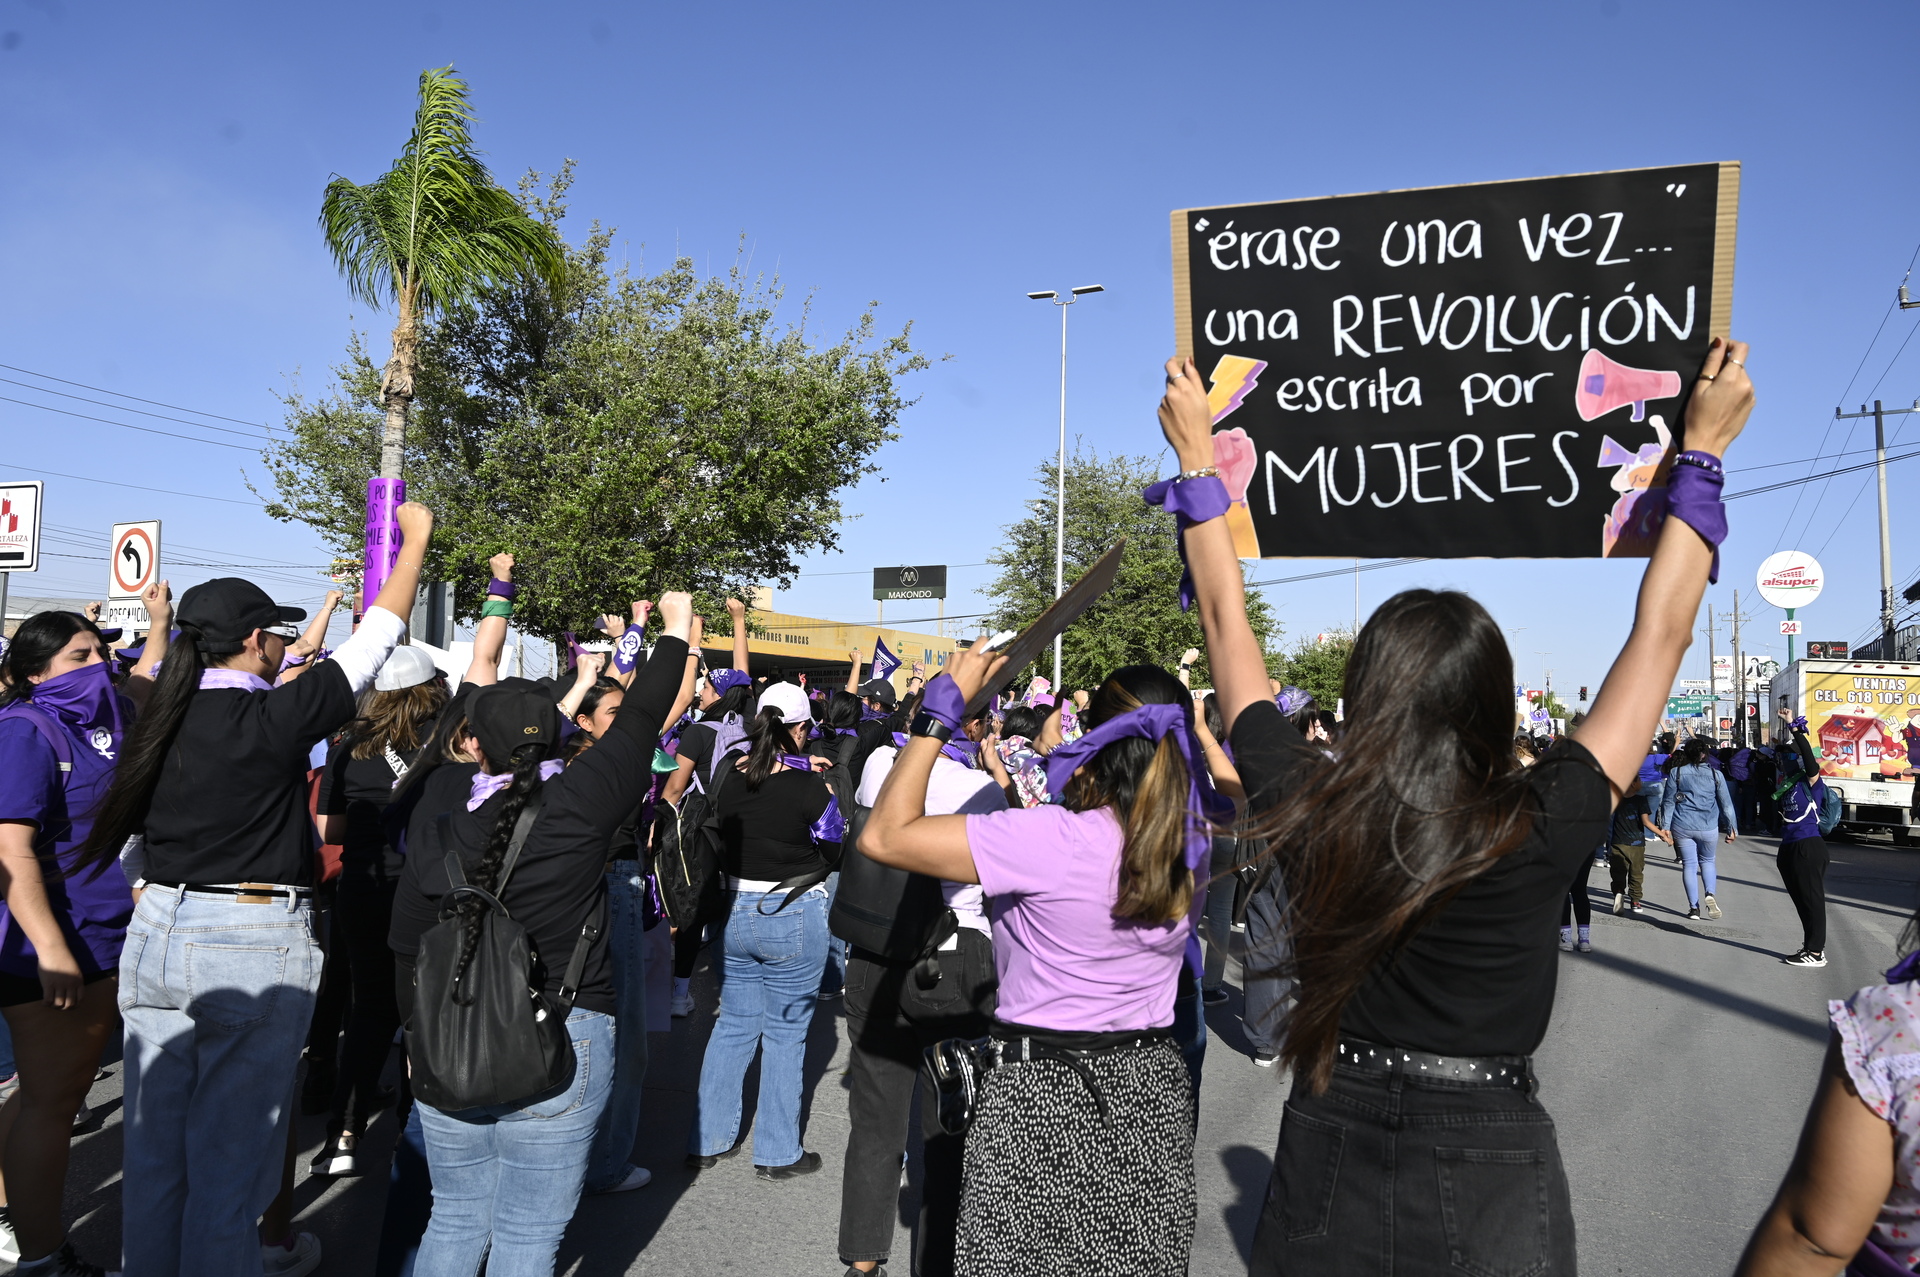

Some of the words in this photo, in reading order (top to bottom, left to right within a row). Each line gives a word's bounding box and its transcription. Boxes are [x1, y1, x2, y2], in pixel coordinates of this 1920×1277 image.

[1380, 219, 1483, 268] una
[1204, 308, 1299, 346] una
[1276, 366, 1423, 414] escrita
[1460, 372, 1554, 416] por
[1265, 430, 1580, 516] MUJERES
[0, 535, 28, 543] TALEZA
[1762, 578, 1818, 587] alsuper
[888, 590, 932, 599] MAKONDO
[1781, 622, 1797, 633] 24
[785, 634, 809, 645] MARCAS
[1853, 677, 1906, 691] VENTAS
[1814, 689, 1843, 702] CEL.
[1847, 691, 1873, 704] 618
[1877, 692, 1903, 704] 105
